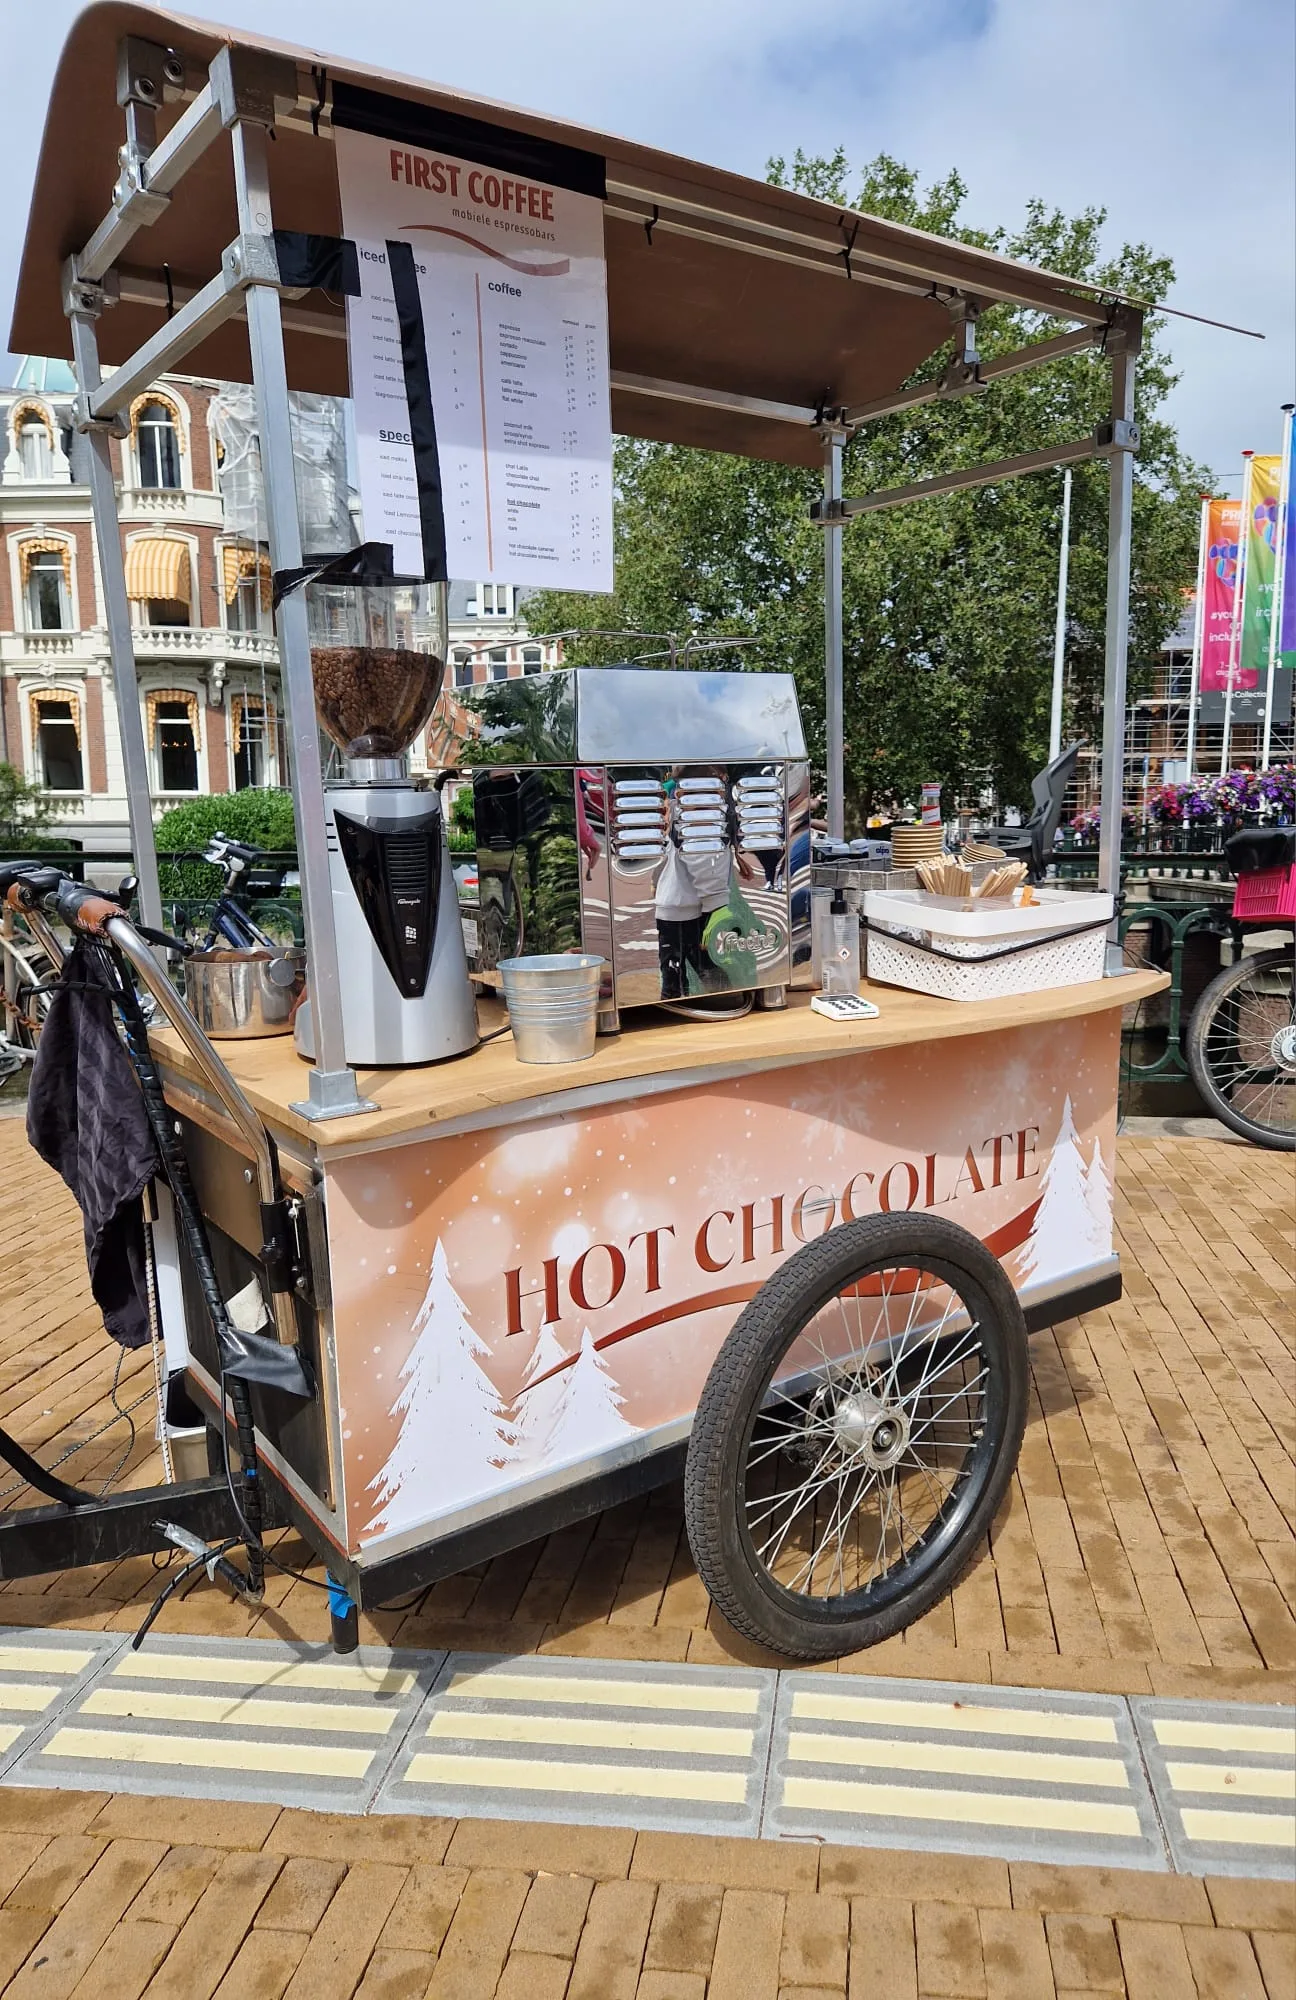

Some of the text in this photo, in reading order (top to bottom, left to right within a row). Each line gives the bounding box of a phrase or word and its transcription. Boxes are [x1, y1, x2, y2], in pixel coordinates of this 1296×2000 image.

[390, 148, 554, 222] FIRST COFFEE
[452, 208, 556, 241] mobiele espressobars
[360, 247, 386, 264] iced
[488, 281, 522, 297] coffee
[379, 429, 413, 442] spec
[504, 1126, 1041, 1337] HOT CHOCOLATE
